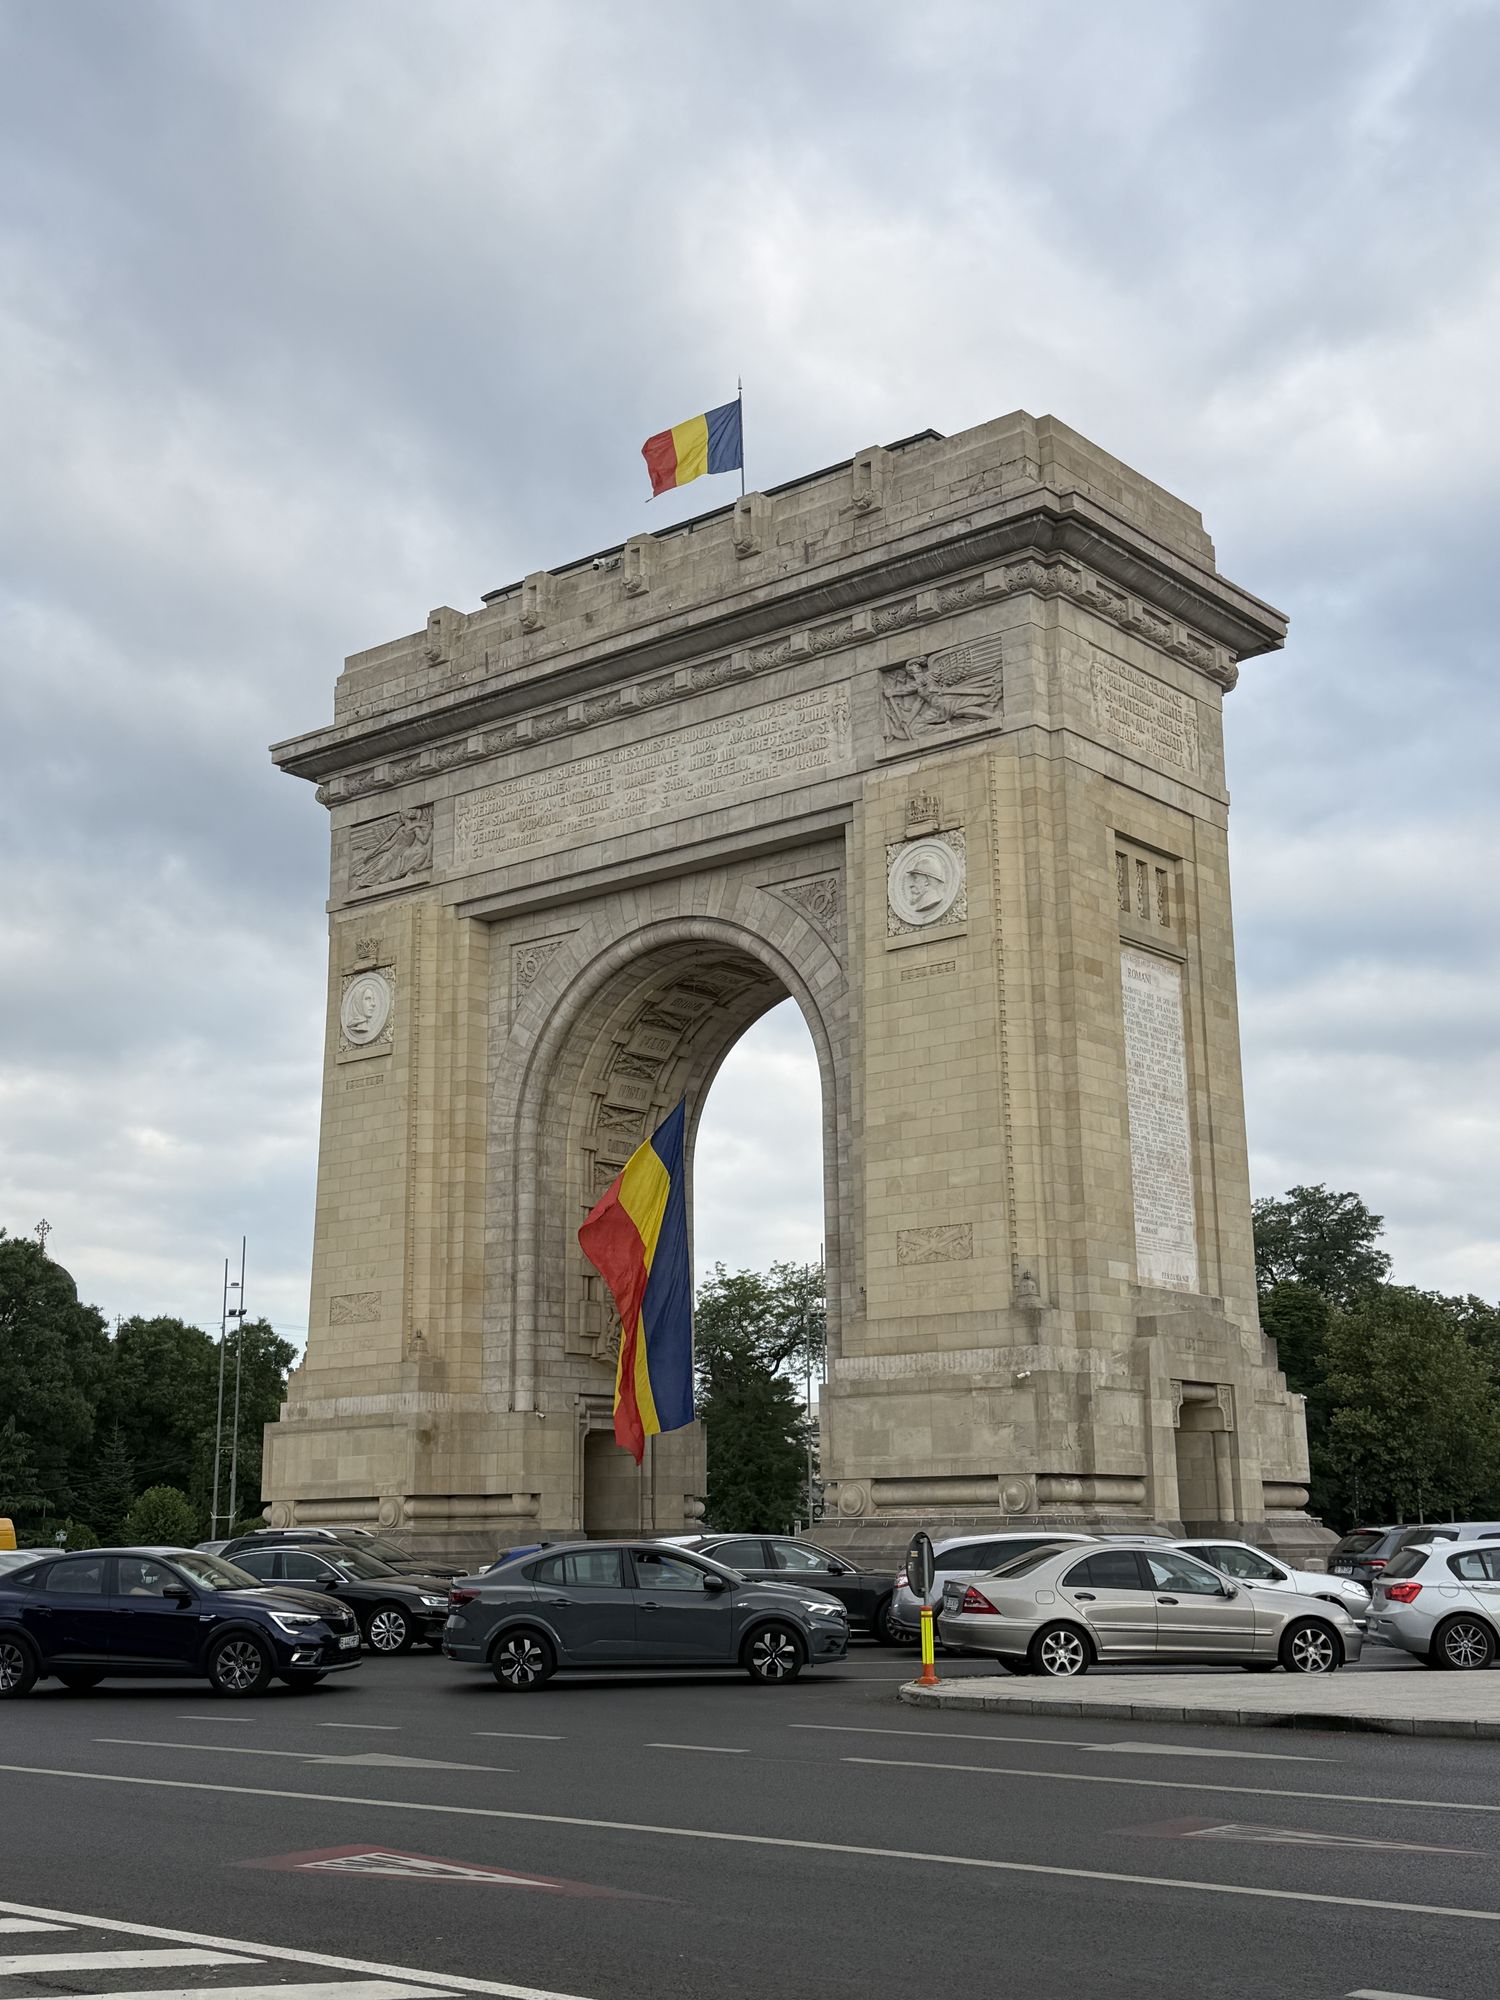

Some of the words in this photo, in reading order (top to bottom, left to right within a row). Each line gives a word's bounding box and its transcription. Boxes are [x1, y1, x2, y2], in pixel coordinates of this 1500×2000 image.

[472, 819, 484, 833] DE
[665, 764, 679, 778] SE
[501, 777, 534, 797] SECOLE
[540, 772, 552, 785] DE
[558, 756, 609, 780] SUFERINTE
